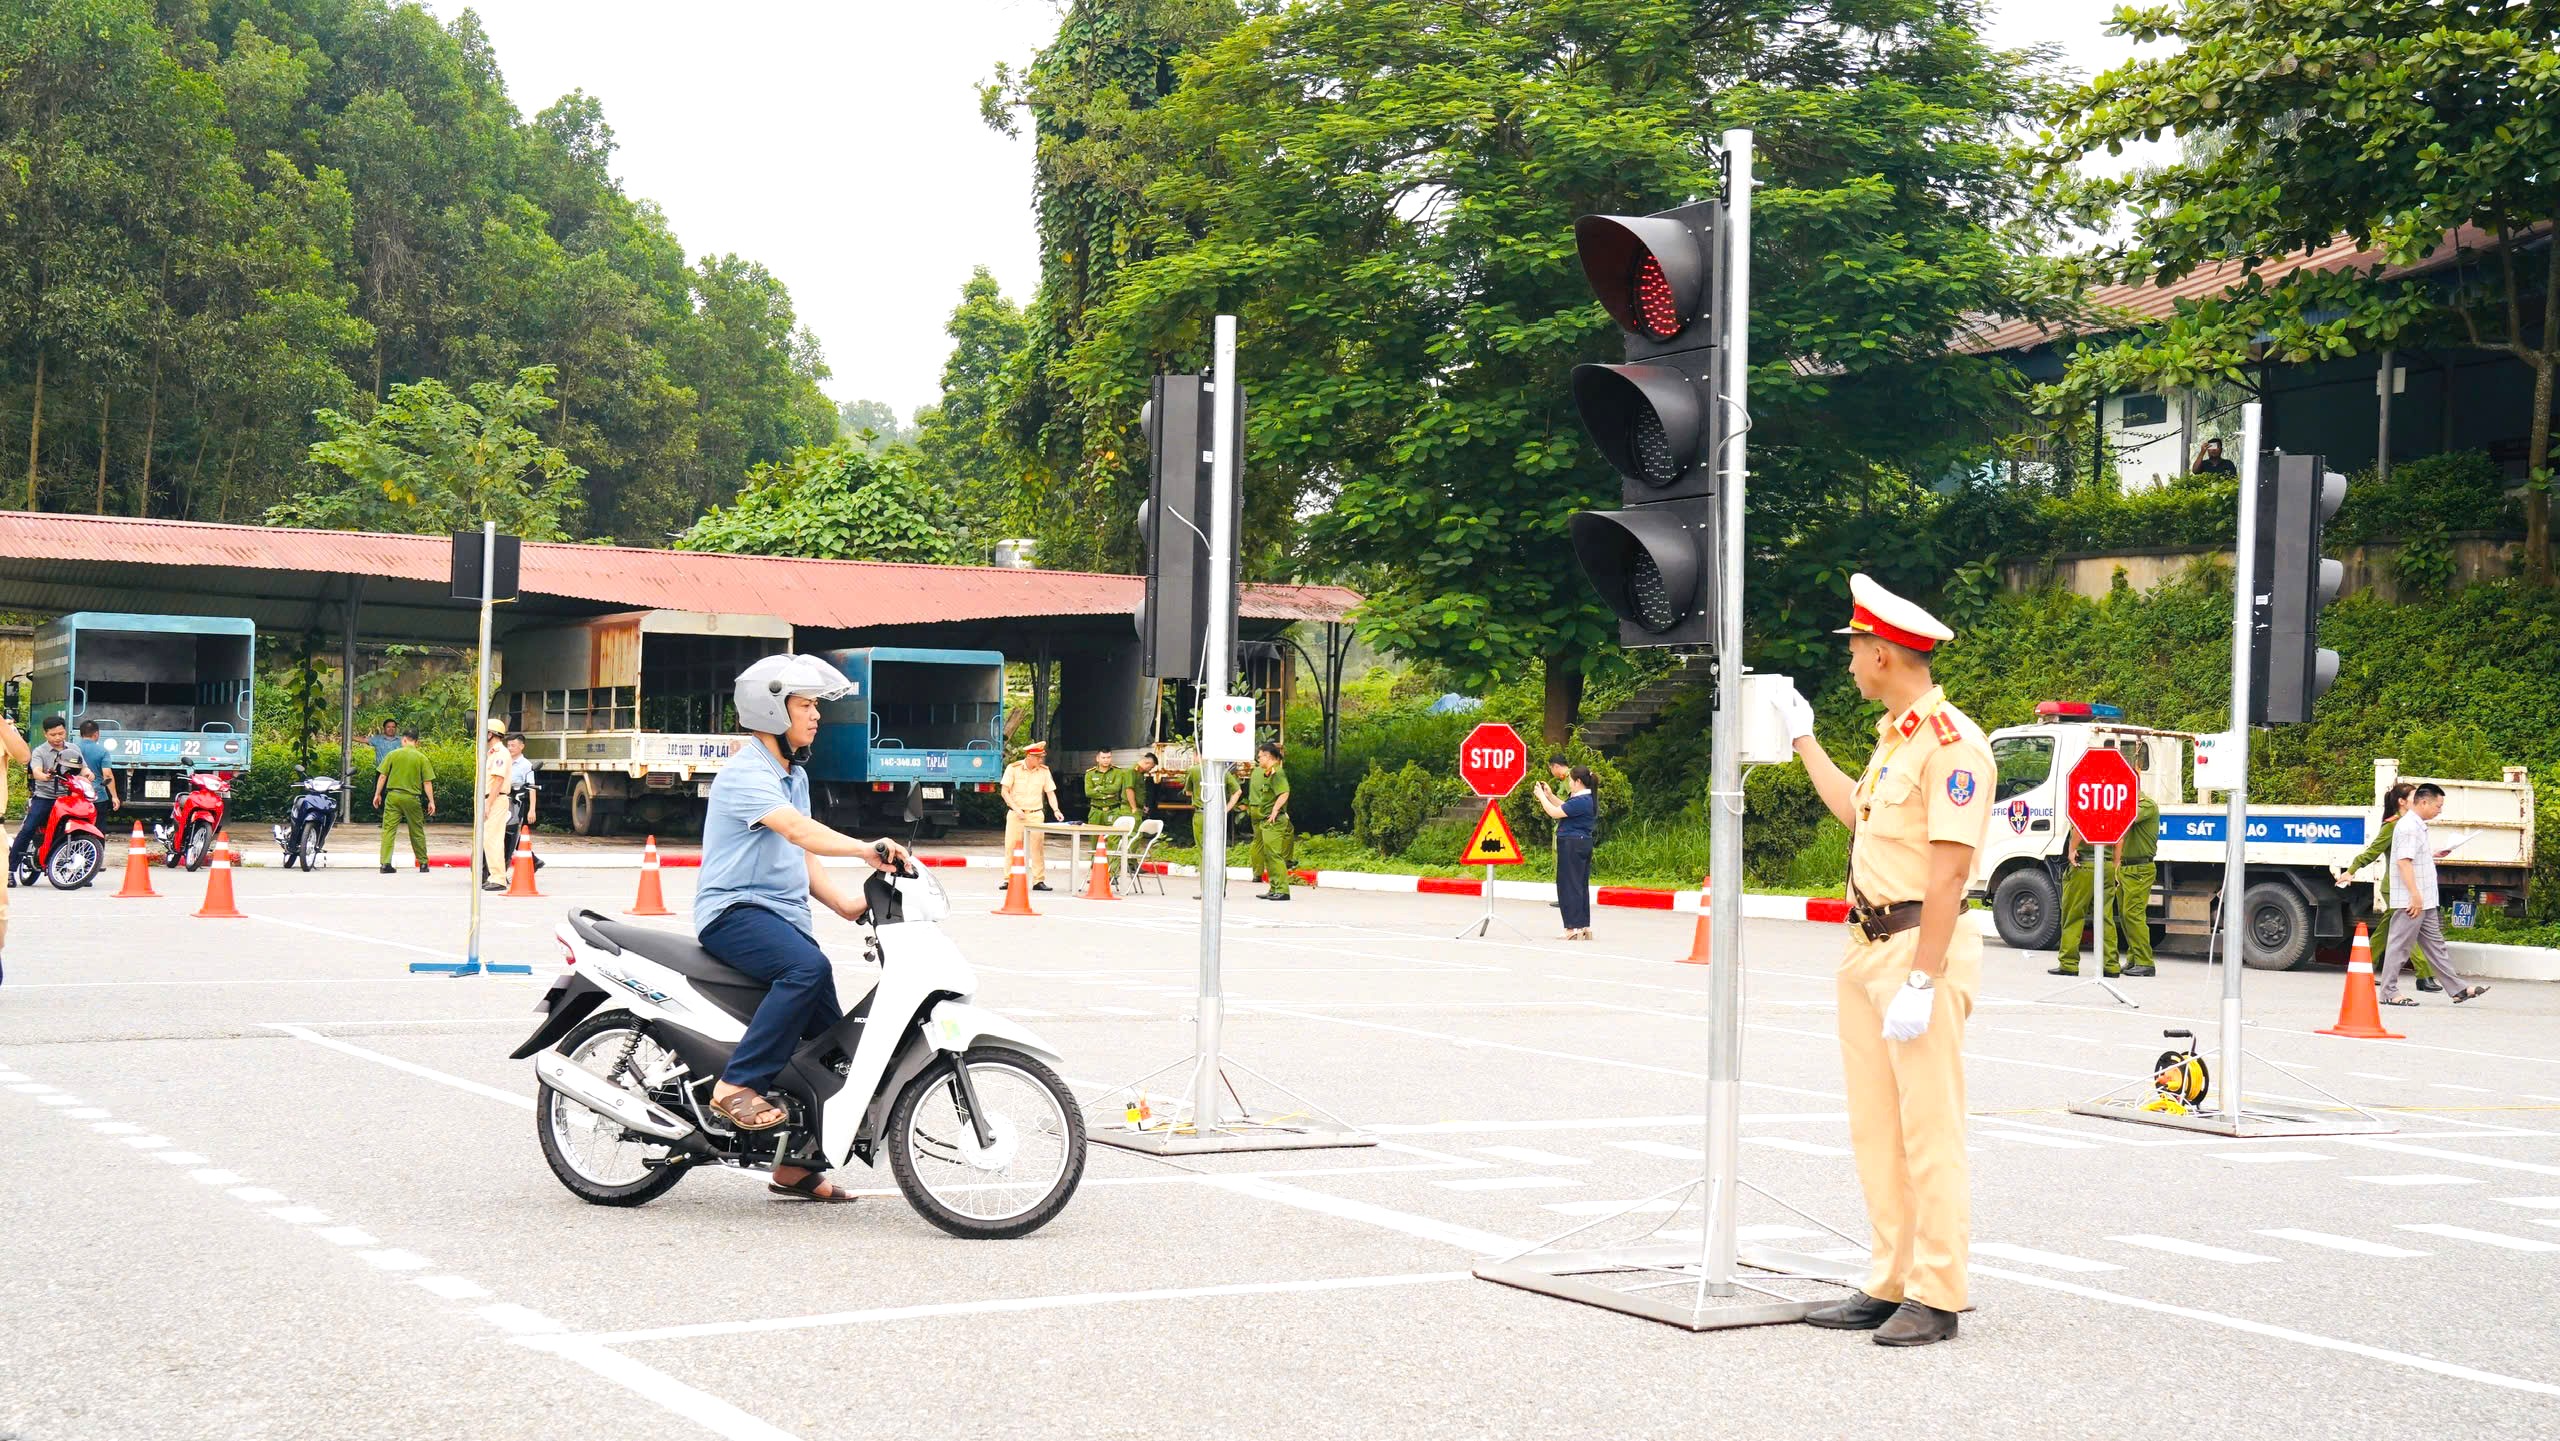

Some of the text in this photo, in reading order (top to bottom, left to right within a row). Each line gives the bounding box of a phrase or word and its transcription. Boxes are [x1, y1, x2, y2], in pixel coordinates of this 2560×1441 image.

[125, 740, 140, 754] 20
[144, 740, 162, 754] TẬP
[699, 741, 715, 759] TẬP
[1471, 748, 1515, 769] STOP
[2078, 783, 2128, 811] STOP
[1992, 807, 2053, 816] FFIC POLICE
[2186, 820, 2216, 836] SÁT
[2246, 824, 2267, 837] AO
[2284, 822, 2341, 838] THÔNG
